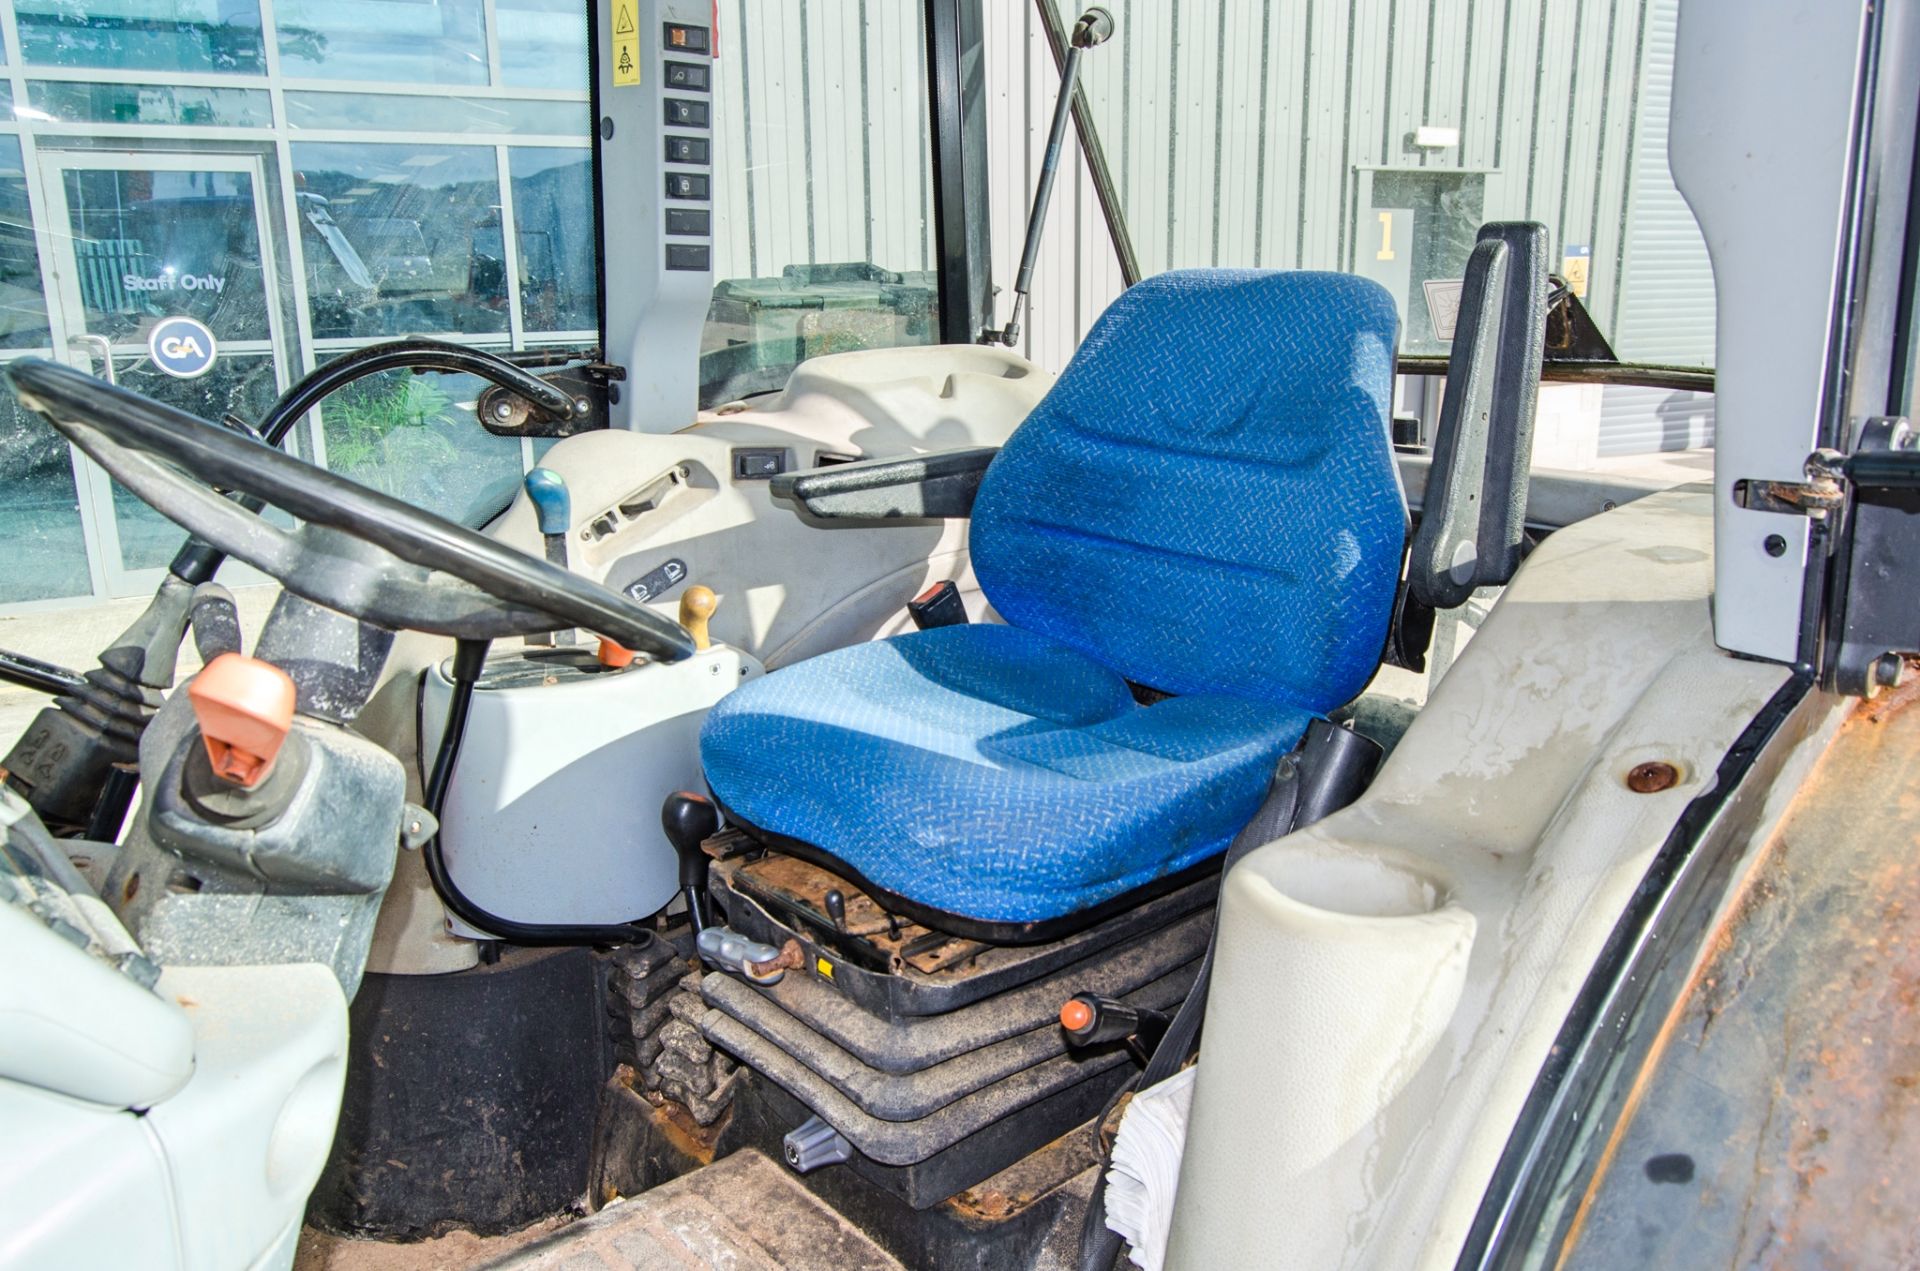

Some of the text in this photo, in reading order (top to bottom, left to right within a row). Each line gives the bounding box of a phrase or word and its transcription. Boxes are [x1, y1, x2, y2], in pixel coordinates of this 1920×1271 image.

[1376, 212, 1395, 260] 1
[124, 274, 225, 293] Staff Only
[161, 336, 205, 359] GA
